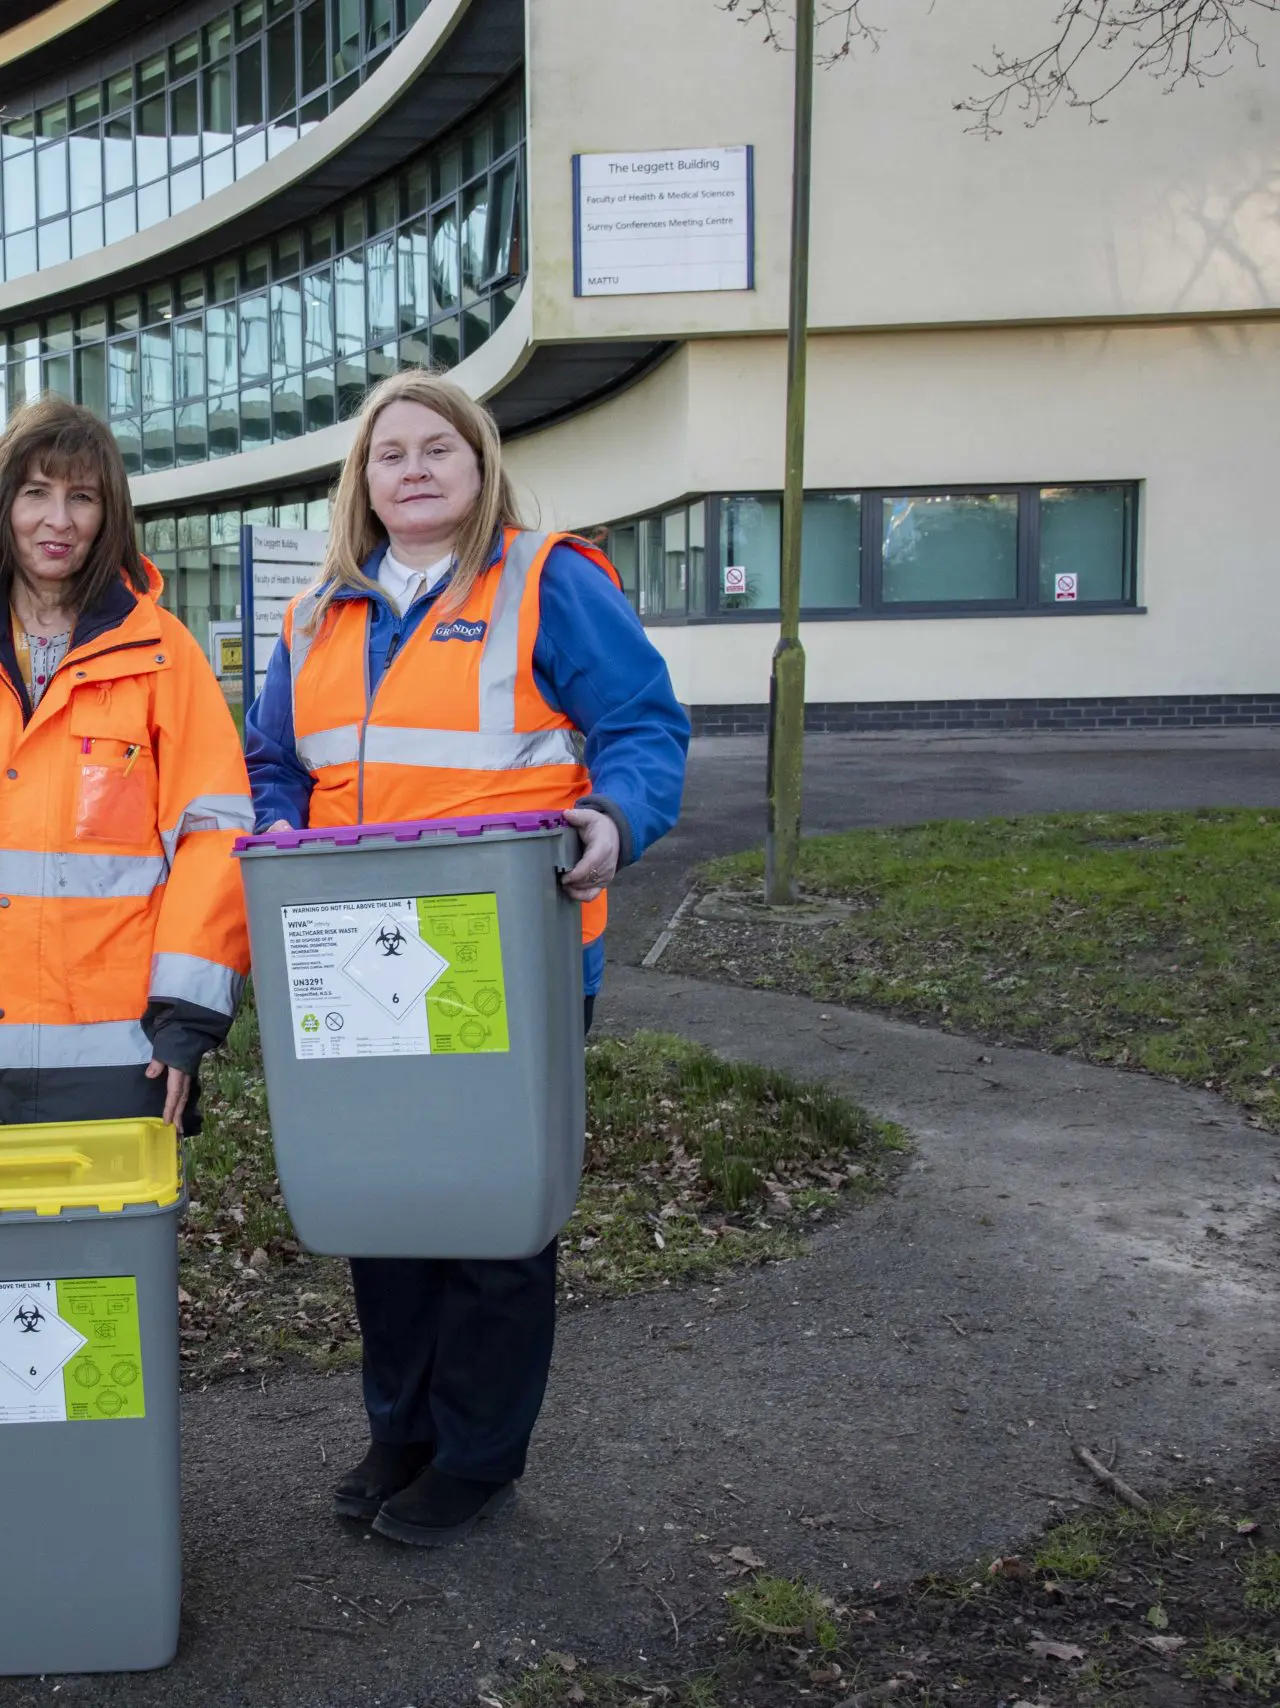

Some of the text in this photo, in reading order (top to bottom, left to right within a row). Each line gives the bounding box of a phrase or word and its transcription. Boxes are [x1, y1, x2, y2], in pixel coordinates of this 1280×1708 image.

[609, 159, 720, 174] The Leggett Building
[587, 195, 614, 204] Faculty
[618, 194, 627, 202] of
[629, 193, 656, 201] Health
[668, 191, 699, 199] Medical
[701, 190, 735, 198] Sciences
[587, 217, 733, 231] Surrey Conferences Meeting Centre
[588, 277, 619, 285] MATTU
[289, 929, 324, 937] HEALTHCARE
[293, 978, 323, 986] UN3291
[392, 993, 399, 1004] 6
[29, 1367, 37, 1376] 6
